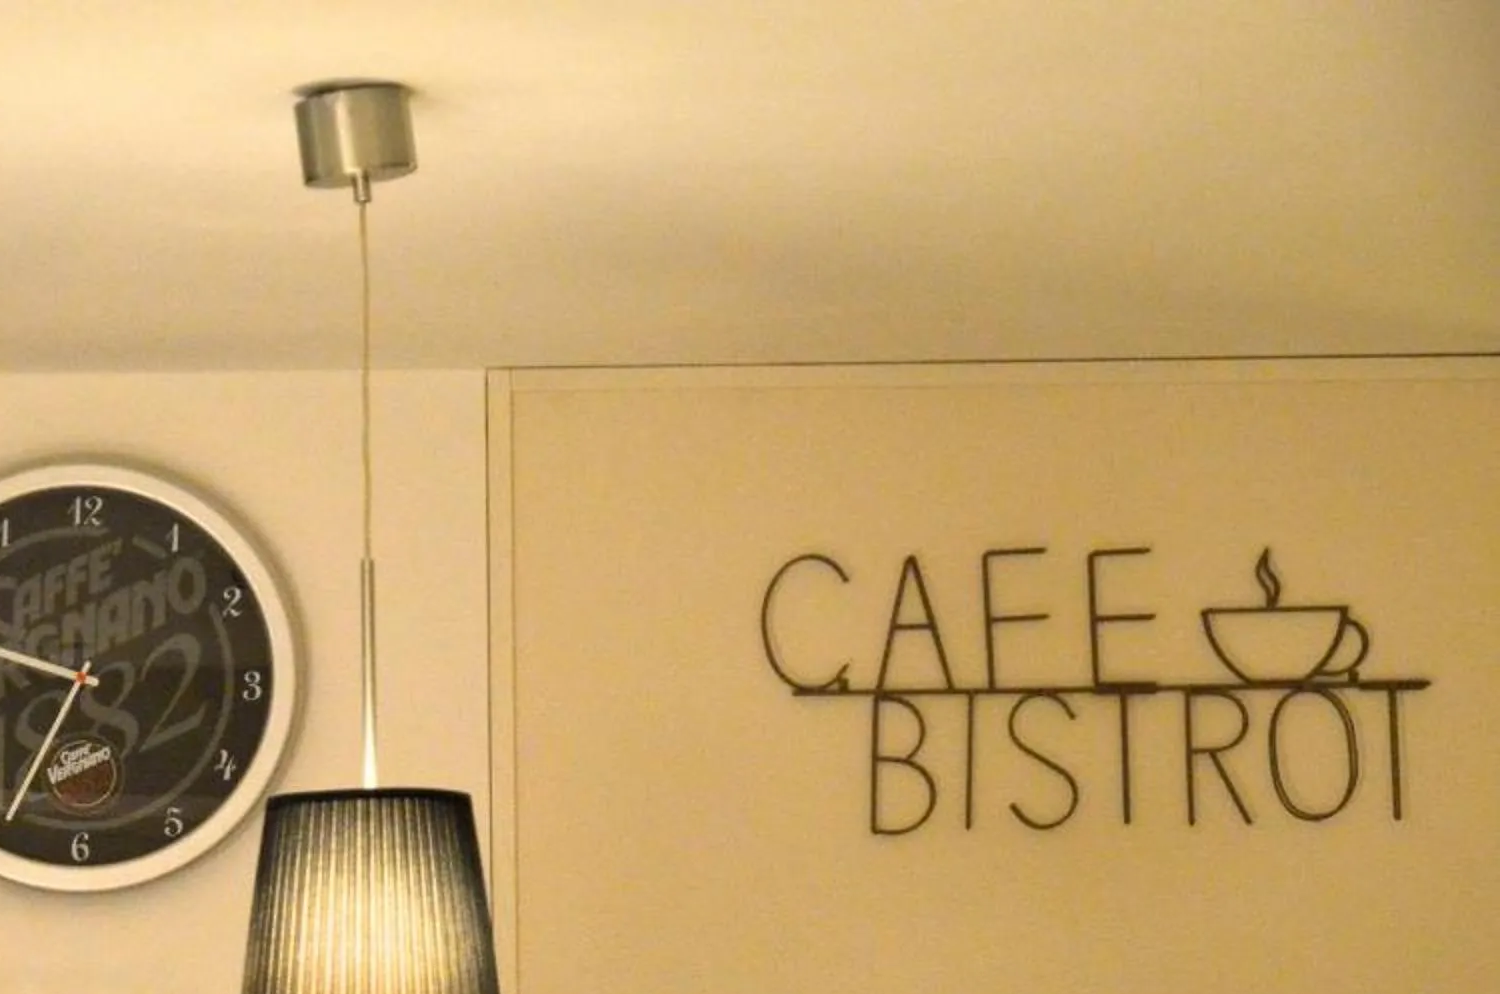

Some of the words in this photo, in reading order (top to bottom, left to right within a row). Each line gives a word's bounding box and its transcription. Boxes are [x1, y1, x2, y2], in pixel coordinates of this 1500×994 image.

[67, 496, 102, 526] 12
[165, 523, 180, 552] 1
[223, 587, 242, 617] 2
[761, 547, 1157, 692] CAFE
[243, 671, 262, 700] 3
[215, 749, 236, 781] 4
[871, 683, 1431, 834] BISTROT
[164, 808, 183, 837] 5
[71, 832, 90, 861] 6
